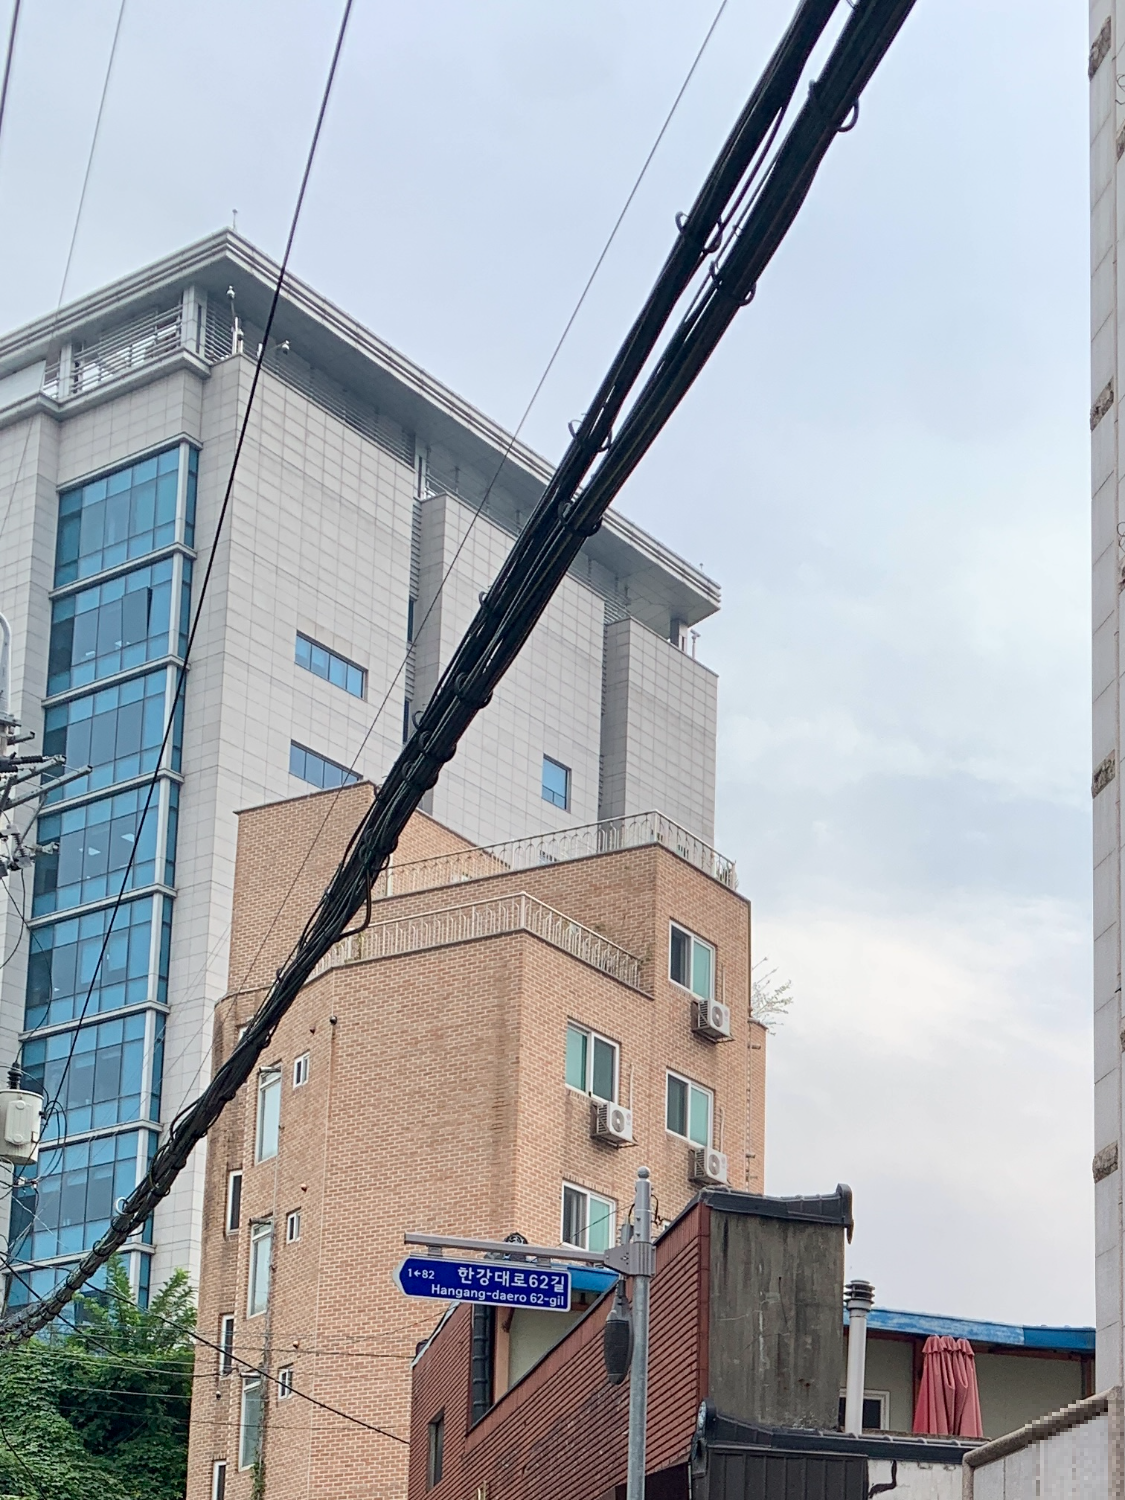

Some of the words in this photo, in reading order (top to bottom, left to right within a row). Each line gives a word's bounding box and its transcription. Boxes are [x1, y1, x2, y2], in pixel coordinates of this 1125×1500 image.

[421, 1269, 435, 1280] 82
[457, 1266, 565, 1293] 한강대로62길
[431, 1284, 527, 1303] Hangang-daero
[530, 1294, 565, 1308] 62-gil
